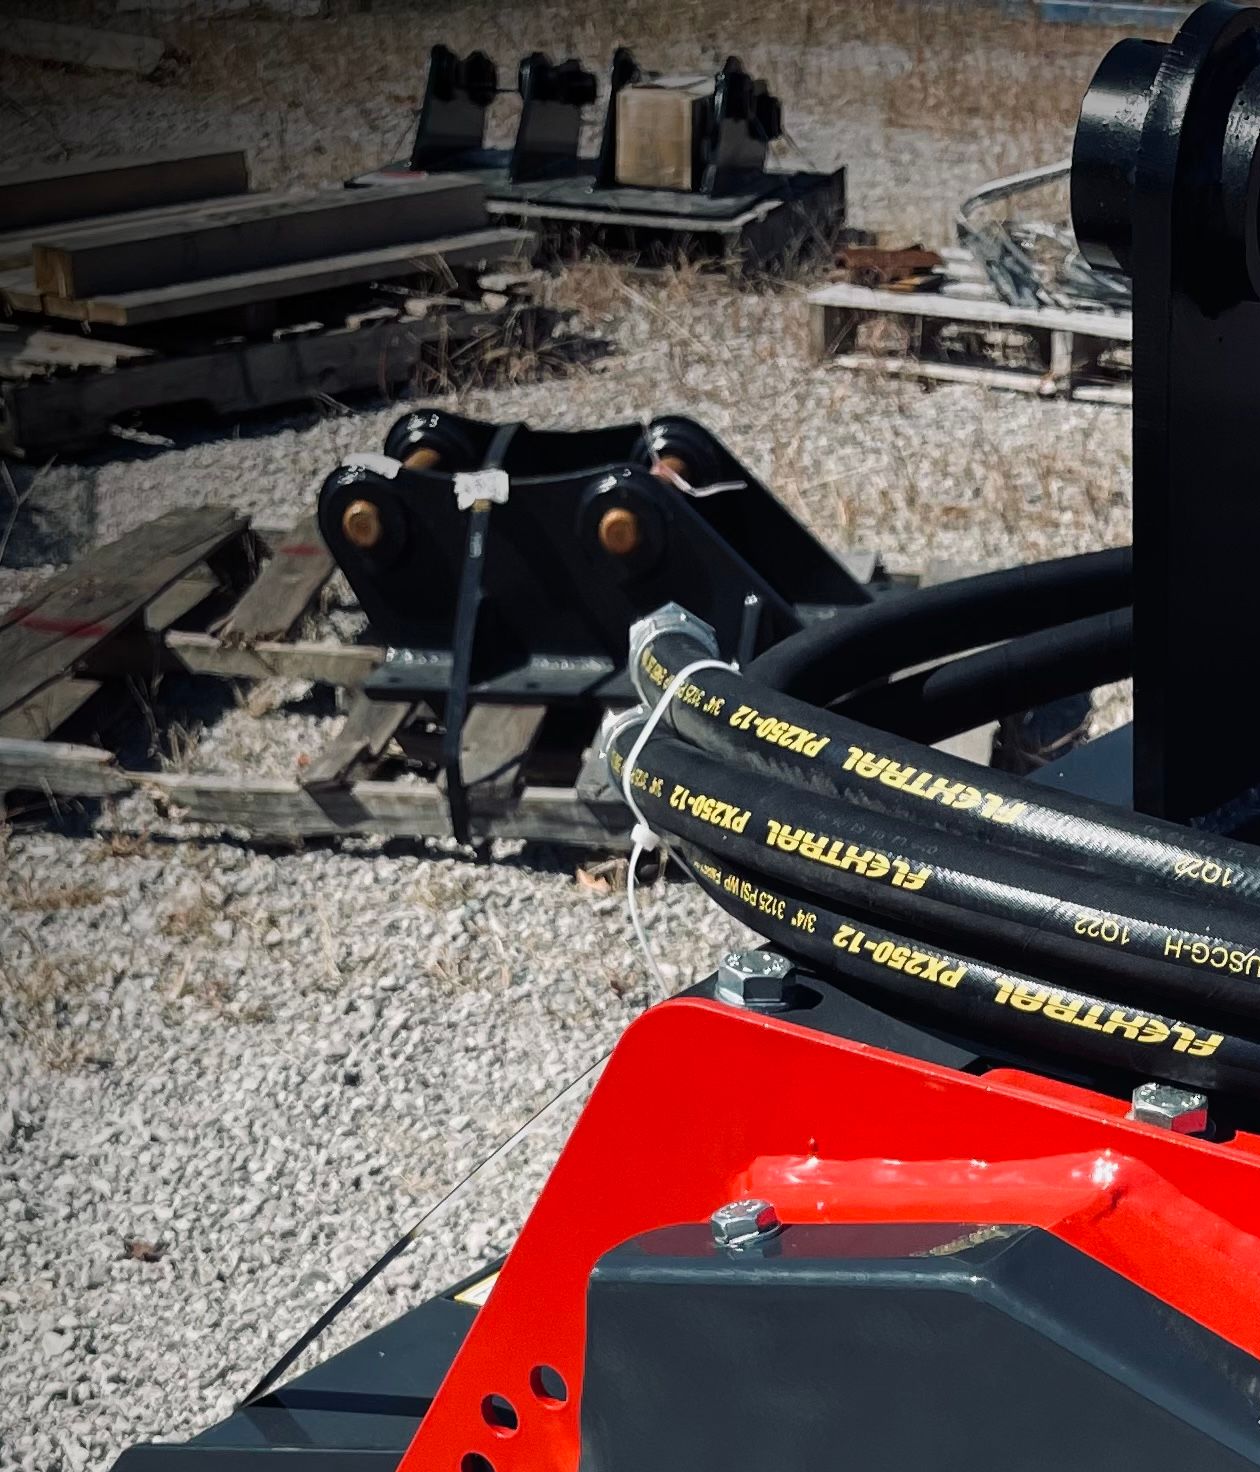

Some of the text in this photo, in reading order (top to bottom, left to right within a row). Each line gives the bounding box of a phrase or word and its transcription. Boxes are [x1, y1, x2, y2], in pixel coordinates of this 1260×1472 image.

[729, 704, 830, 757] PX250-12
[842, 747, 1026, 826] FLEXTRAL
[669, 783, 752, 835] PX250-12
[766, 819, 932, 891] FLEXTRAL
[1173, 853, 1234, 888] 1Q22
[723, 874, 741, 896] WP
[739, 880, 760, 907] PSI
[758, 891, 787, 921] 3125
[789, 908, 818, 934] 3/4"
[1074, 913, 1131, 946] 1Q22
[832, 925, 967, 990] PX250-12
[993, 975, 1225, 1058] FLEXTRAL
